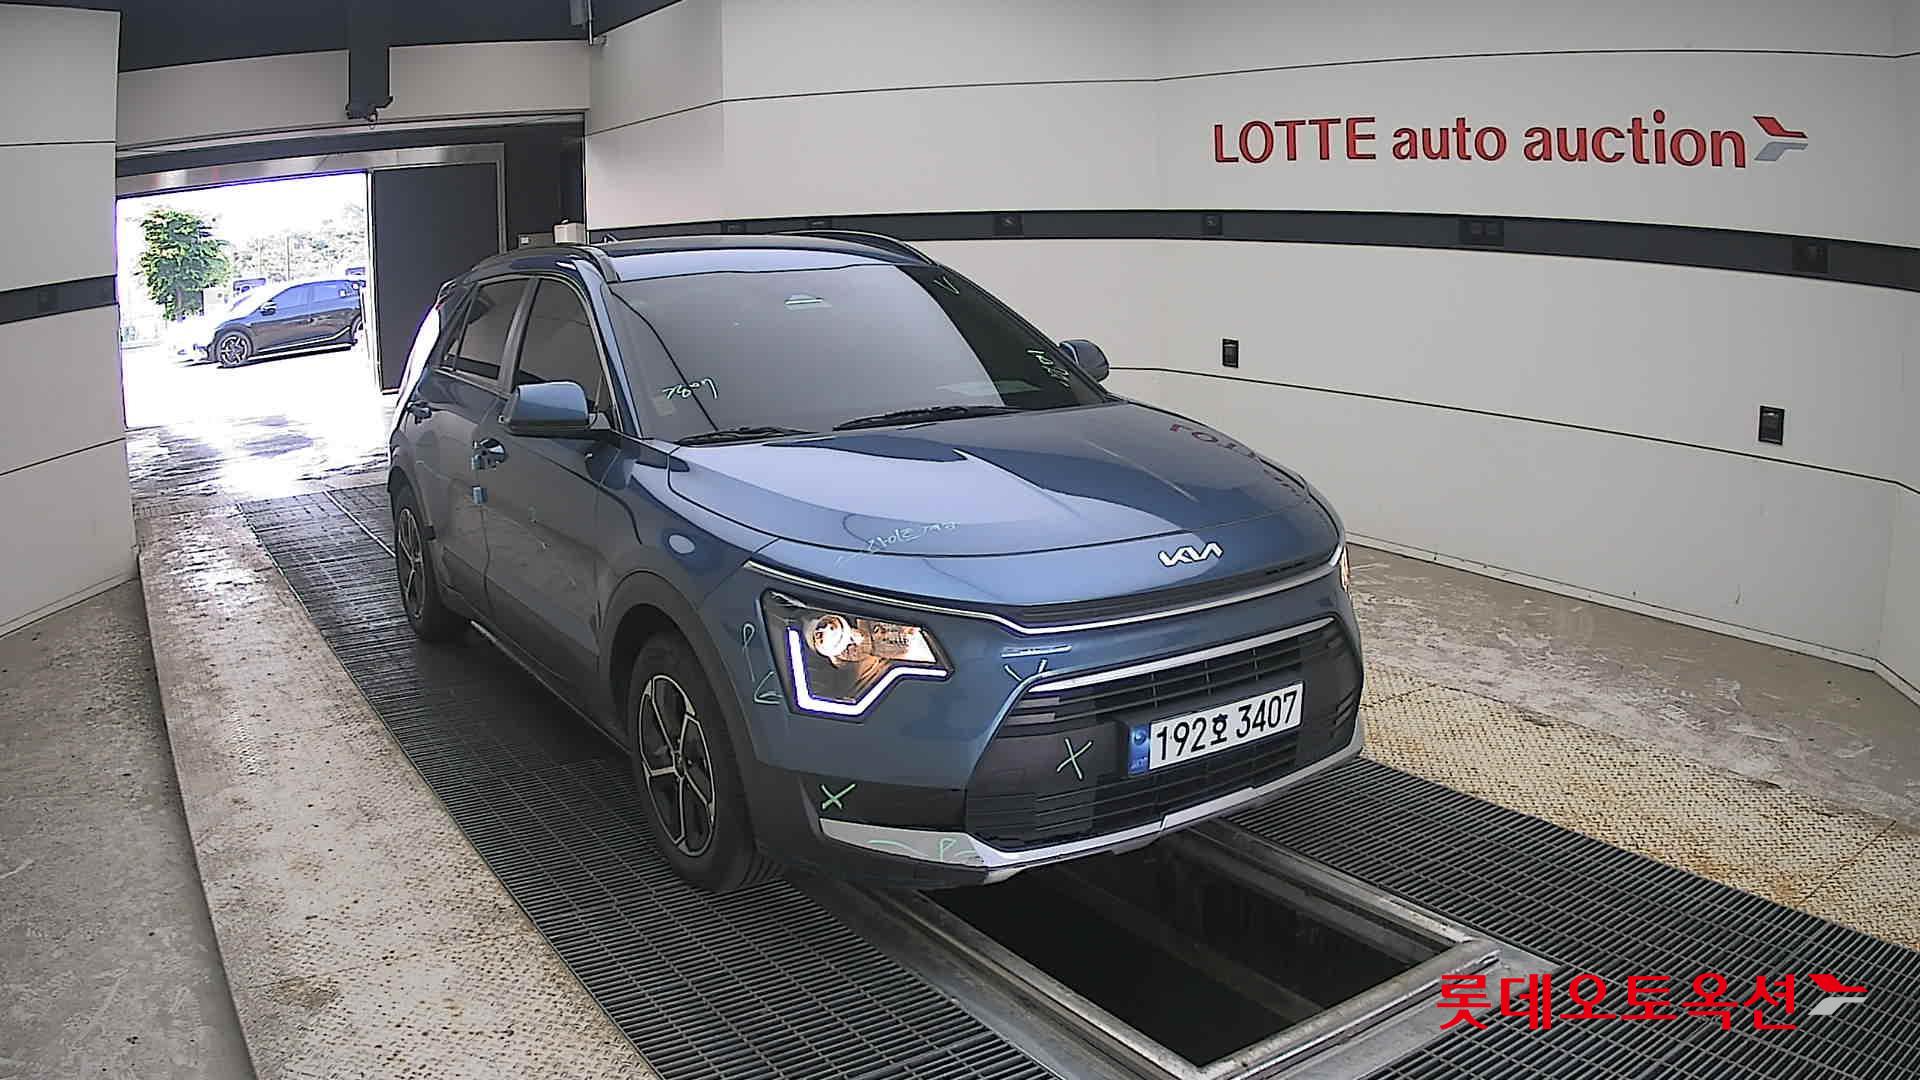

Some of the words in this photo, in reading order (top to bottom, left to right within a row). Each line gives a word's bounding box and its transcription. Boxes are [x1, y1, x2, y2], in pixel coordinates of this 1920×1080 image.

[1213, 116, 1377, 163] LOTTE
[1392, 116, 1508, 162] auto
[1523, 109, 1747, 169] auction
[1158, 541, 1224, 567] KIA
[1156, 713, 1229, 761] 192호
[1236, 690, 1298, 739] 3407
